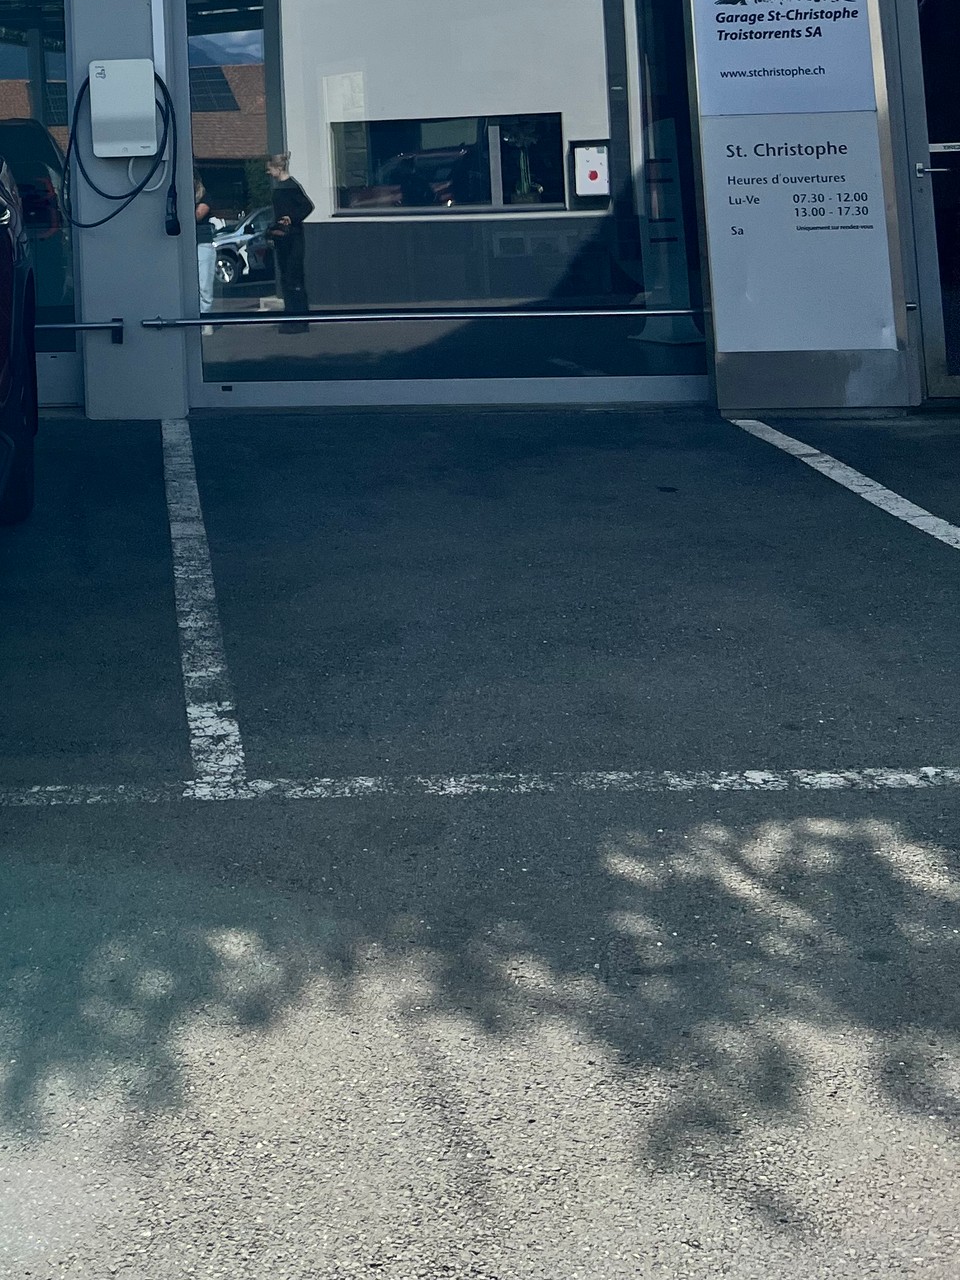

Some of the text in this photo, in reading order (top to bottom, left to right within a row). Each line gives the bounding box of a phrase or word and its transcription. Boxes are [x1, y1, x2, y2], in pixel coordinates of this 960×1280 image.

[715, 7, 859, 25] Garage St-Christophe
[717, 26, 822, 41] Troistorrents SA
[720, 65, 826, 78] www.stchristophe.ch
[726, 141, 848, 159] St. Christophe
[727, 173, 846, 185] Heures d'ouvertures
[728, 195, 760, 205] Lu-Ve
[793, 193, 825, 203] 07.30
[836, 192, 868, 202] 12.00
[794, 207, 825, 217] 13.00
[837, 206, 869, 216] 17.30
[731, 226, 744, 235] Sa
